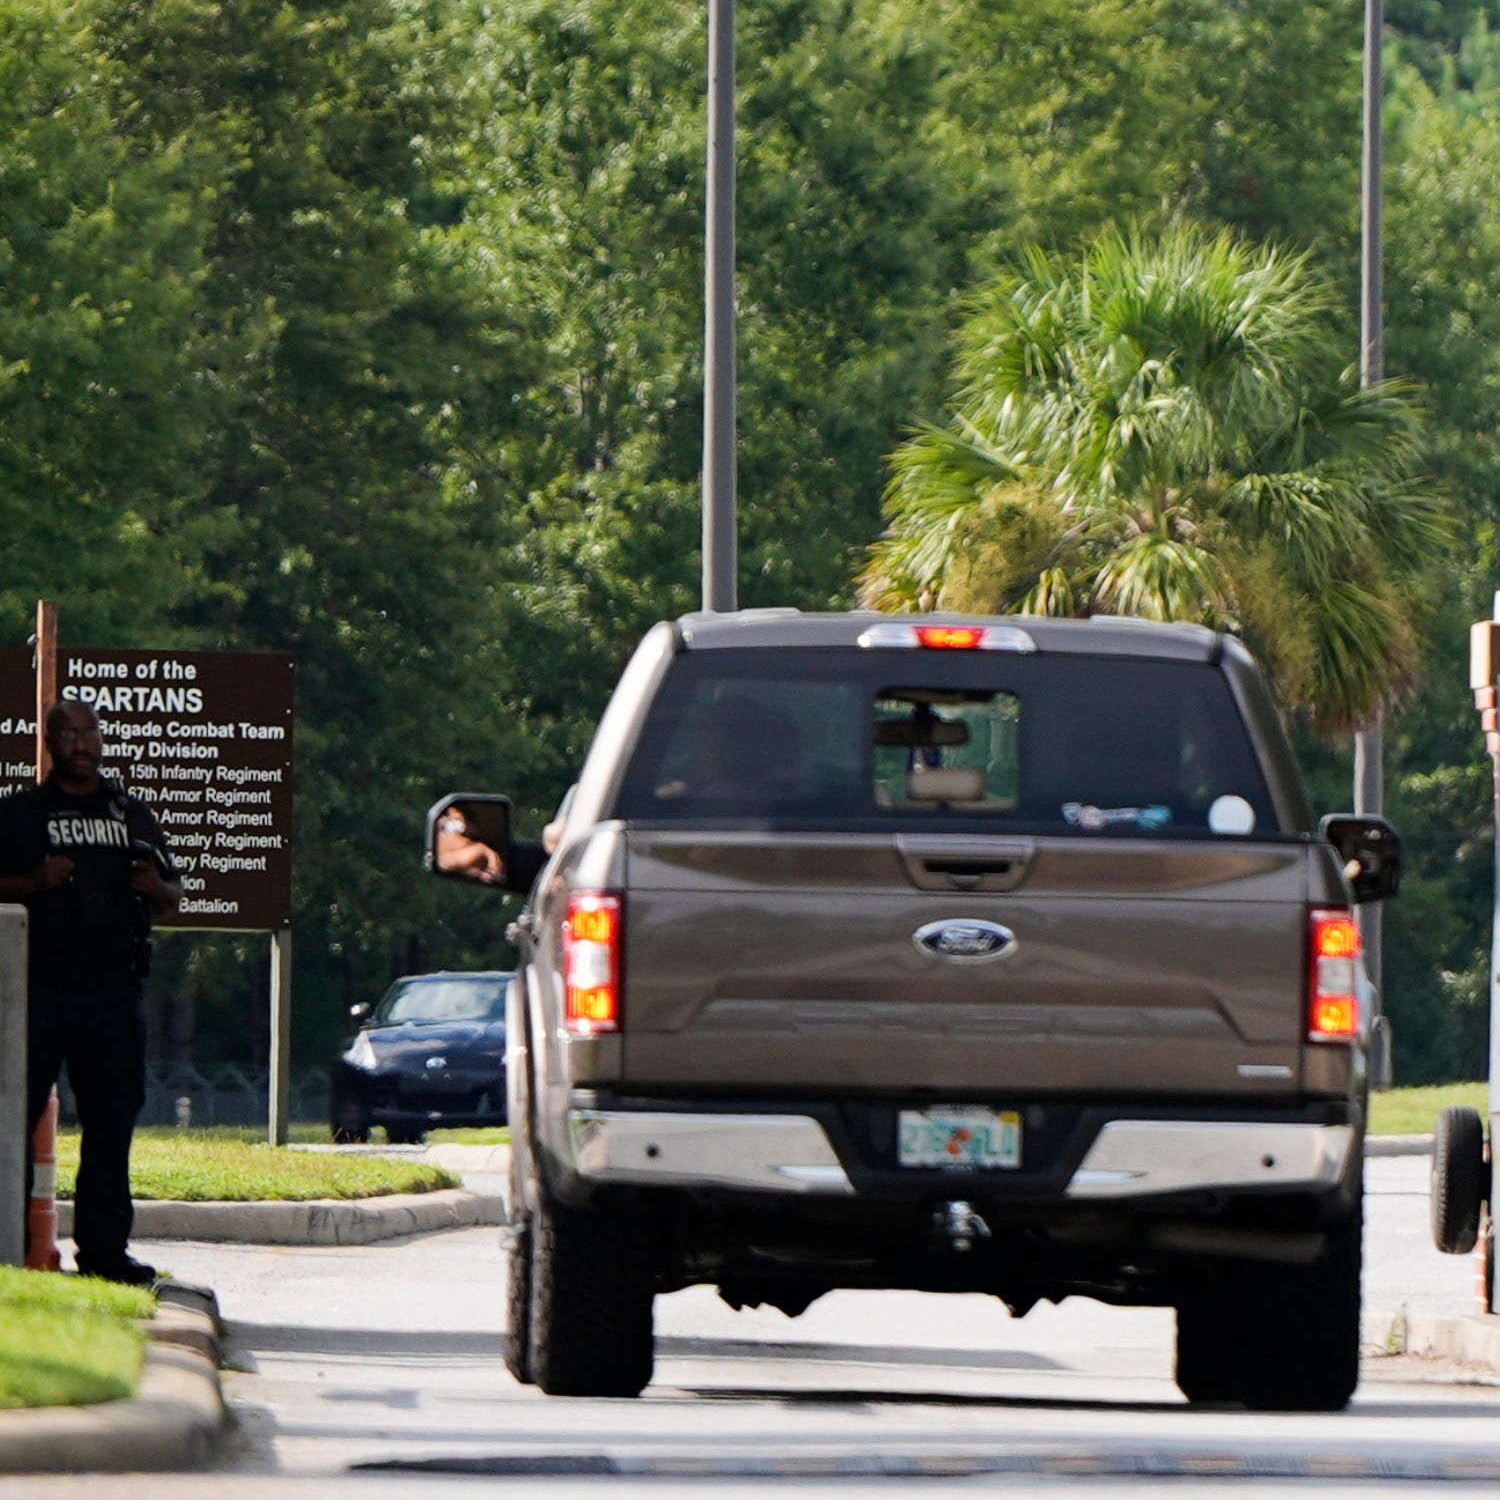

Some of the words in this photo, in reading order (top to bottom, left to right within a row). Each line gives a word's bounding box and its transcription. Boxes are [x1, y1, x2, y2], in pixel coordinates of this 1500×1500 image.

[68, 658, 128, 678] Home
[135, 660, 158, 679] of
[163, 660, 197, 680] the
[62, 685, 203, 713] SPARTANS
[99, 720, 162, 740] Brigade
[166, 721, 234, 738] Combat
[239, 723, 285, 740] Team
[101, 742, 145, 761] antry
[148, 742, 218, 759] Division
[129, 764, 158, 779] 15th
[161, 765, 213, 784] Infantry
[216, 766, 282, 784] Regiment
[159, 787, 202, 802] Armor
[205, 787, 271, 806] Regiment
[160, 809, 203, 824] Armor
[207, 810, 273, 829] Regiment
[47, 817, 129, 847] SECURITY
[215, 831, 282, 851] Regiment
[200, 853, 266, 873] Regiment
[179, 897, 239, 913] Battalion
